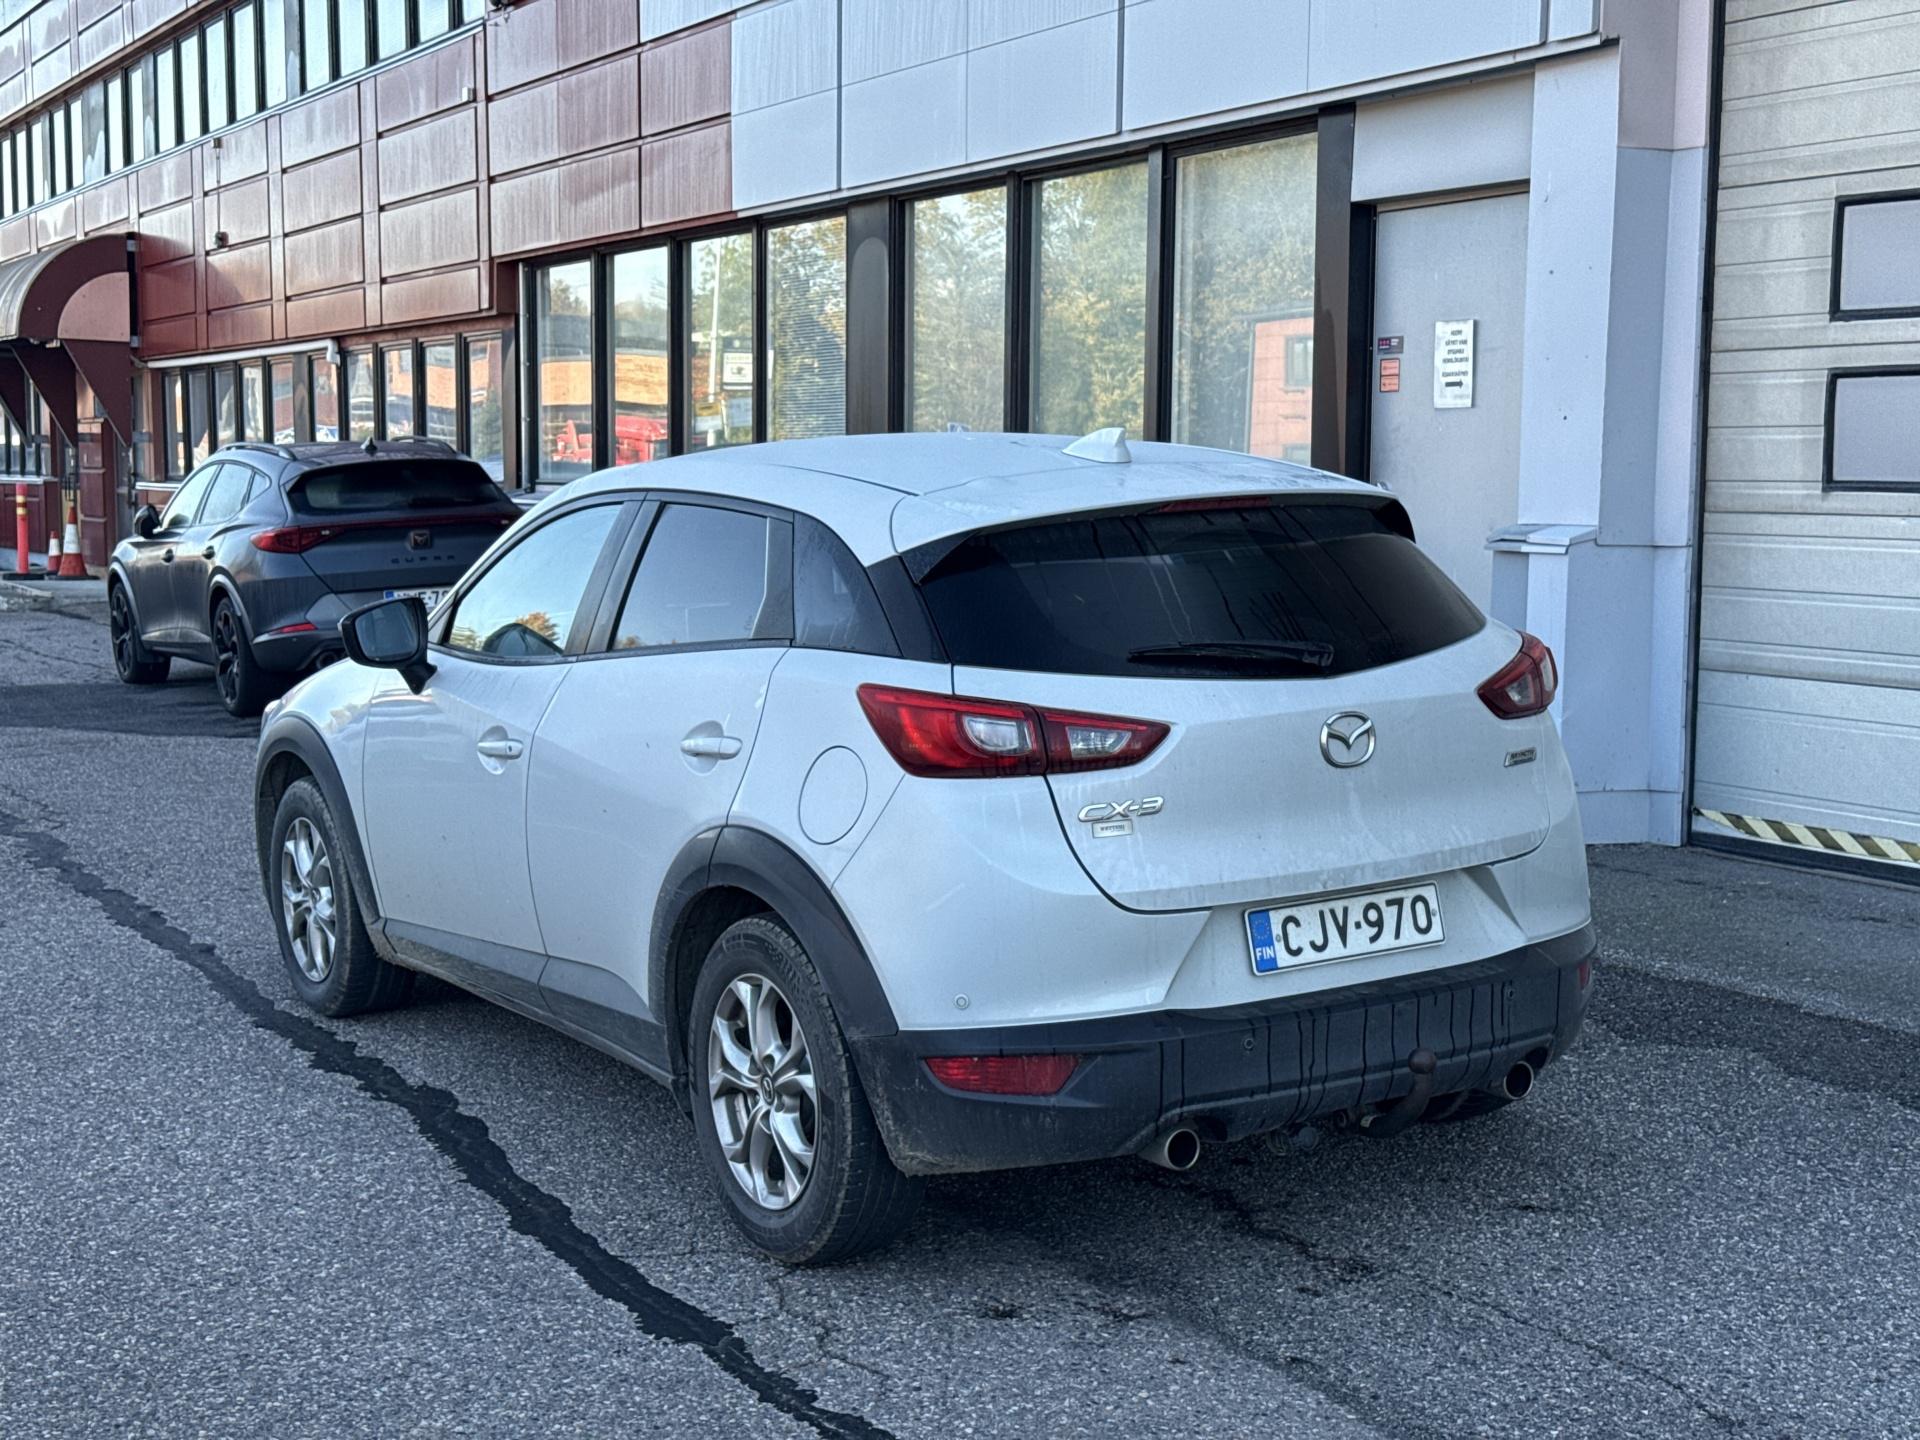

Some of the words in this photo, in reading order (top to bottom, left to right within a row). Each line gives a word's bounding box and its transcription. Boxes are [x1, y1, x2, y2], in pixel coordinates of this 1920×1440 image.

[1077, 795, 1164, 822] CX-3
[1281, 894, 1433, 957] CJV-970
[1256, 945, 1275, 961] FIN
